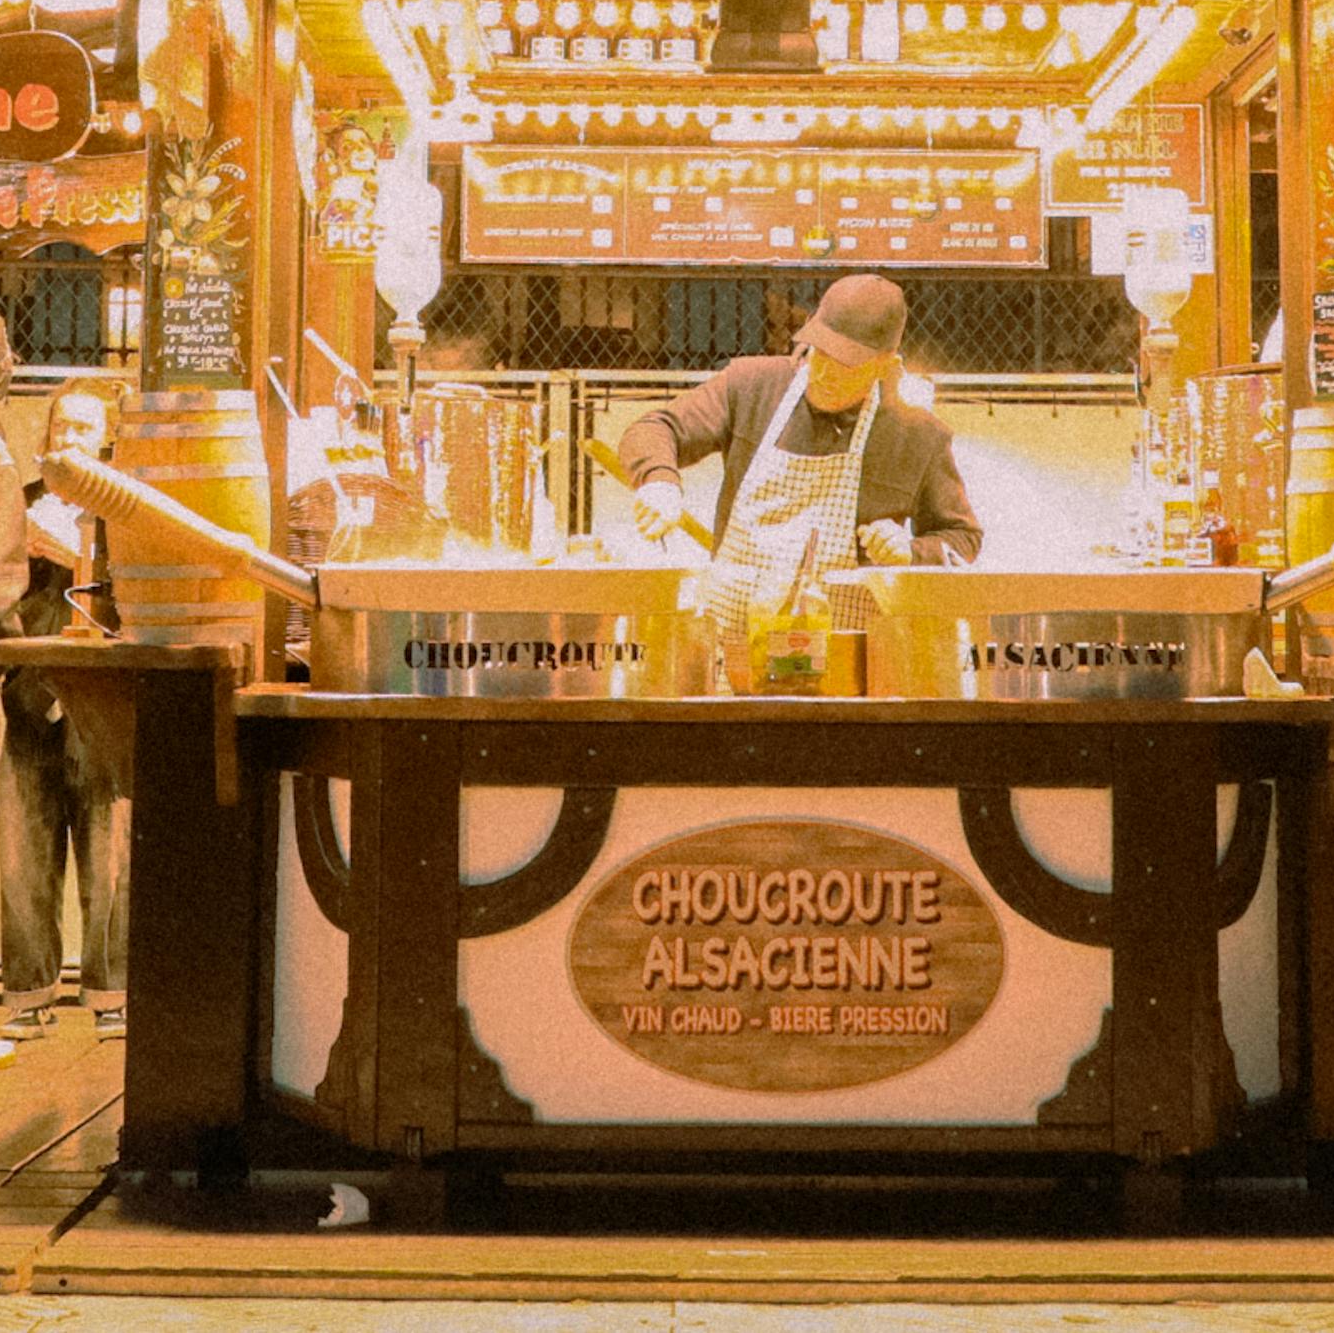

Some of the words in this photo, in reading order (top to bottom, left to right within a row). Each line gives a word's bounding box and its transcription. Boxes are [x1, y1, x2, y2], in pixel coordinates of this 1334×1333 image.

[404, 639, 647, 671] CHOUCROUTE
[632, 868, 943, 926] CHOUCROUTE
[642, 936, 934, 992] ALSACIENNE
[622, 1006, 662, 1035] VIN
[670, 1005, 743, 1035] CHAUD
[769, 1005, 834, 1034] BIERE
[839, 1005, 949, 1035] PRESSION
